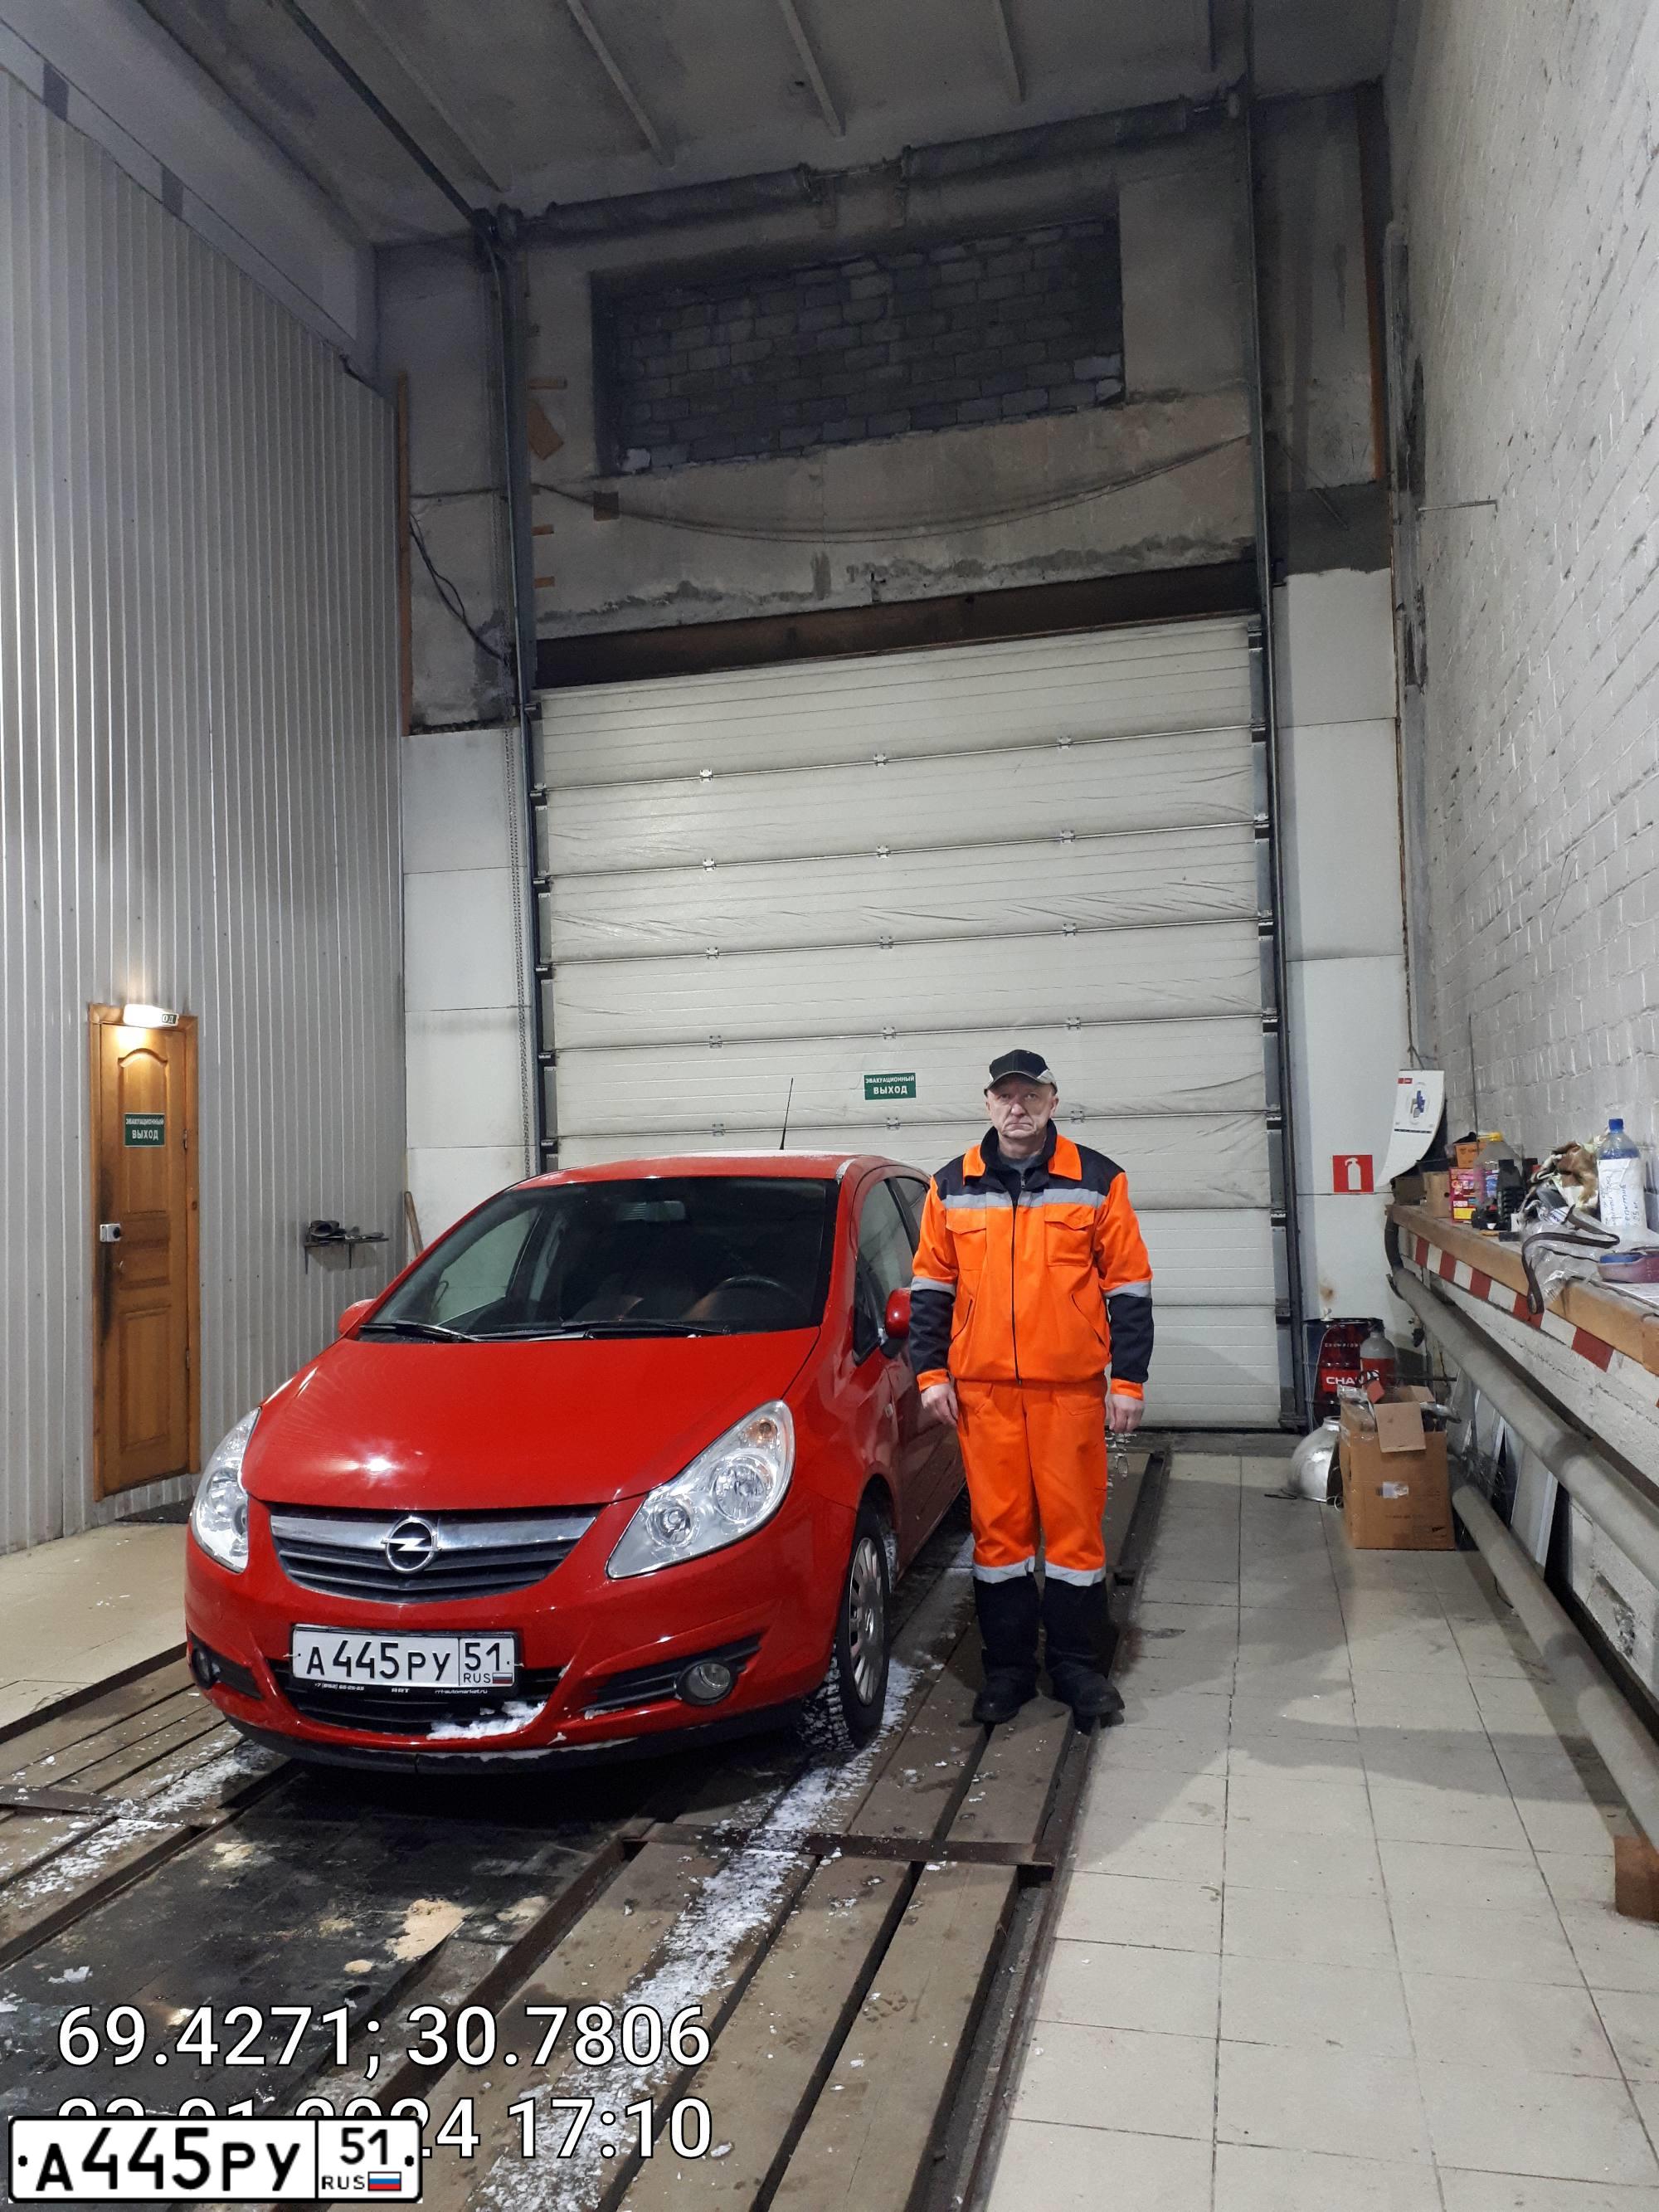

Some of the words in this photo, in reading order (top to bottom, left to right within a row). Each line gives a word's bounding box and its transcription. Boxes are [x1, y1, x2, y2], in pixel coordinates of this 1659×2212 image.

[873, 1086, 907, 1094] ВЫХОД
[132, 1129, 158, 1140] ВЫХОД
[306, 1640, 450, 1682] А445РУ
[465, 1642, 499, 1671] 51
[463, 1673, 491, 1683] RUS
